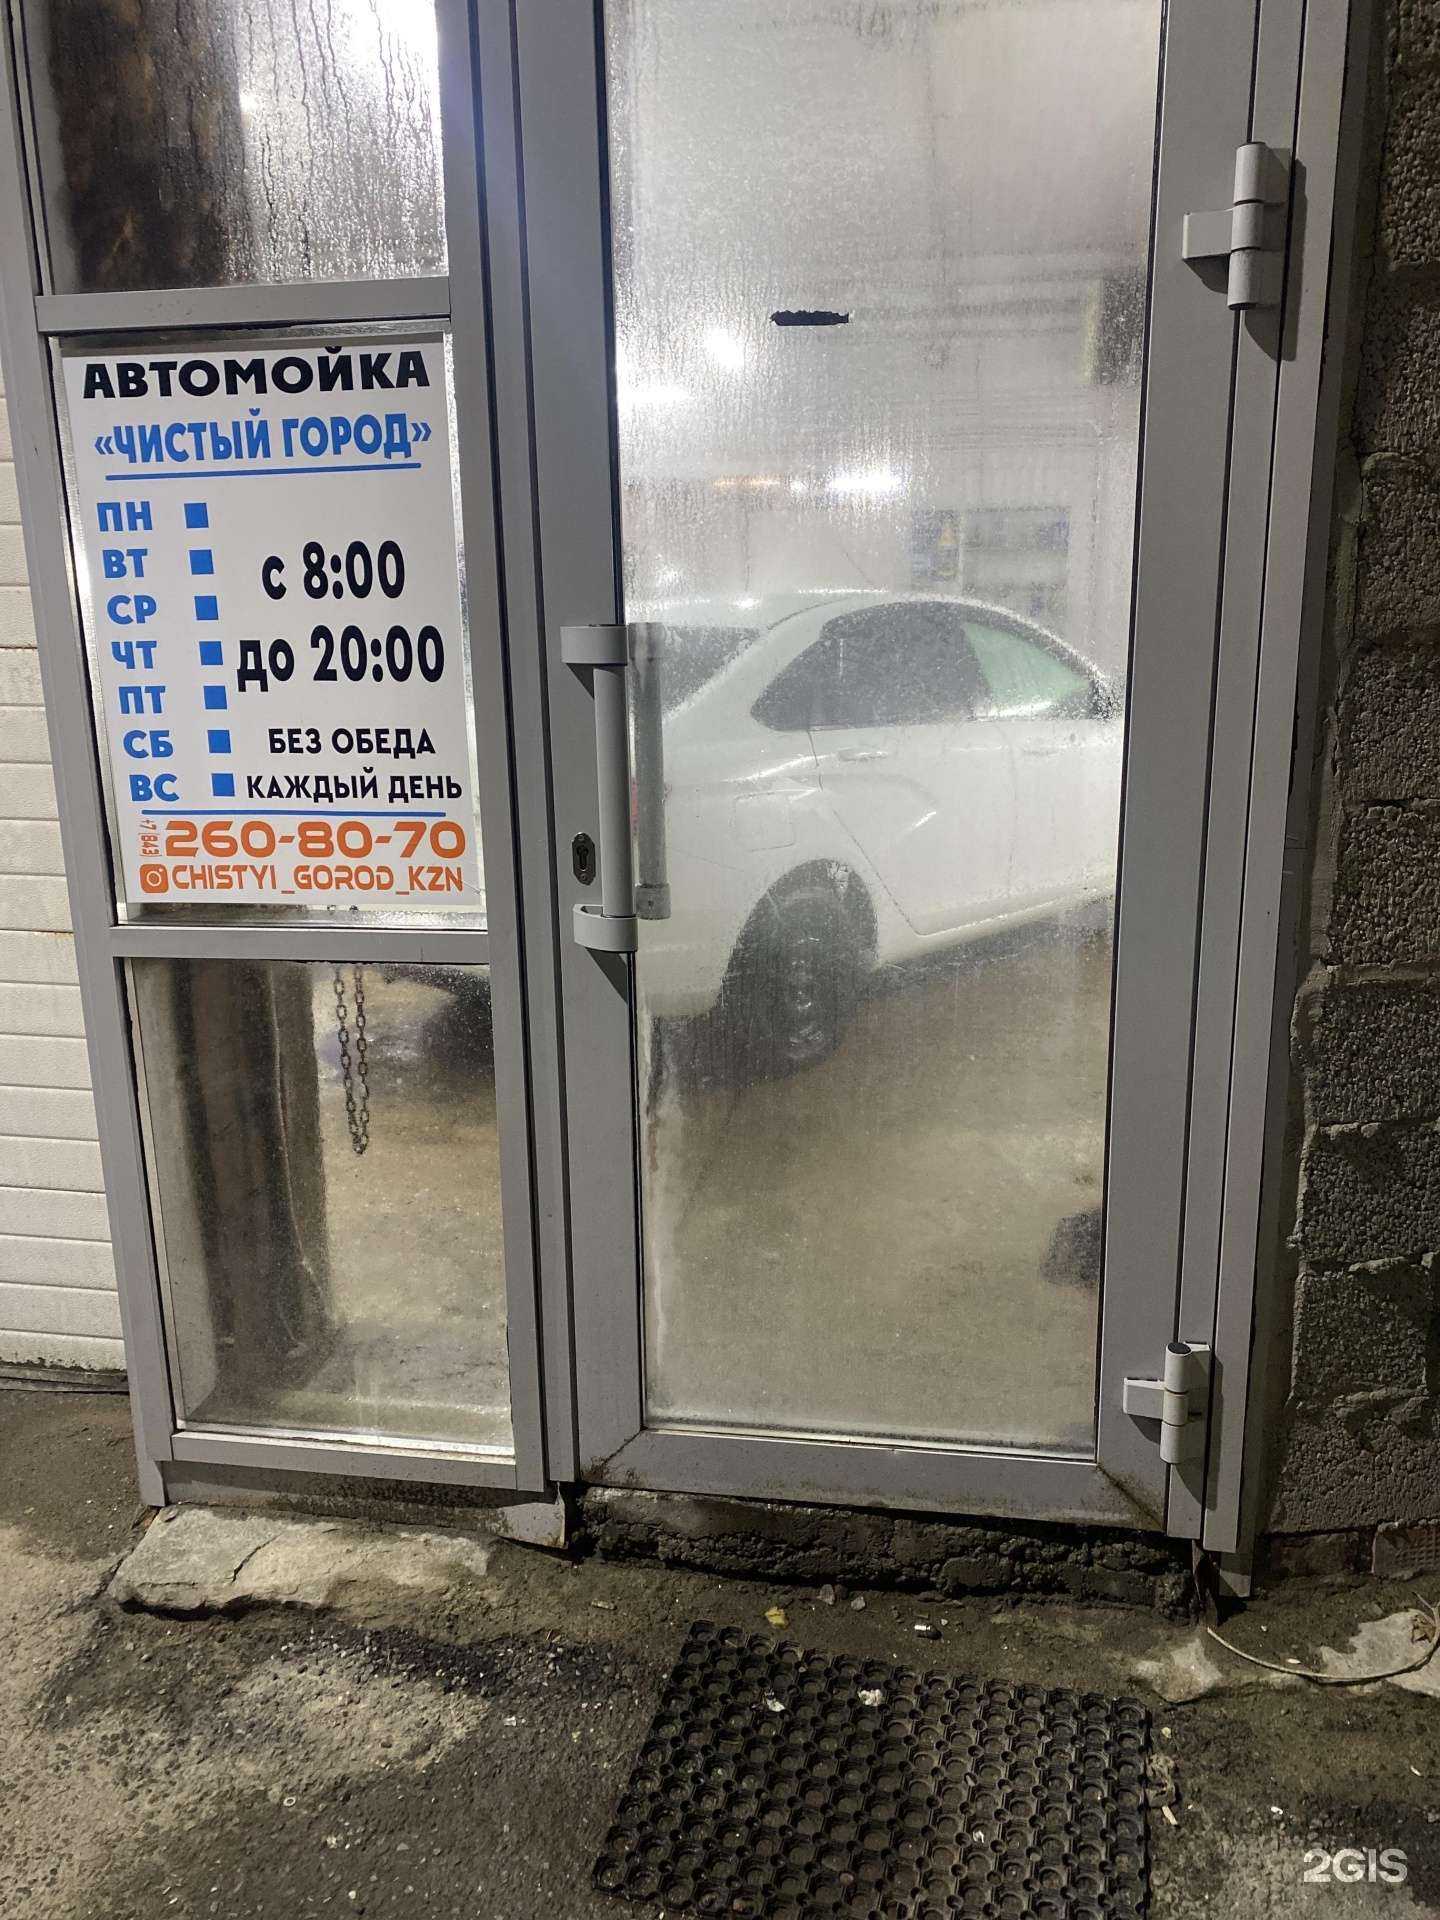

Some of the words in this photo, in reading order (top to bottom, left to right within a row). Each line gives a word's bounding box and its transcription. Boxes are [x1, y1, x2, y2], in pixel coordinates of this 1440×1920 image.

[83, 346, 430, 399] АВТОМОЙКА
[95, 408, 271, 463] «ЧИСТЫЙ
[282, 413, 432, 459] ГОРОД»
[97, 501, 153, 531] ПН
[102, 549, 148, 578] ВТ
[303, 540, 405, 600] 8:00
[107, 594, 157, 625] СР
[111, 641, 157, 669] ЧТ
[237, 639, 295, 692] до
[310, 625, 445, 682] 20:00
[118, 686, 166, 714] ПТ
[123, 730, 173, 758] СБ
[268, 728, 321, 754] БЕЗ
[332, 728, 436, 759] ОБЕДА
[129, 773, 179, 801] ВС
[246, 767, 378, 803] КАЖДЫЙ
[388, 776, 463, 803] ДЕНЬ
[165, 820, 466, 859] 260-80-70
[172, 864, 463, 895] CHISTYI_GOROD_KZN
